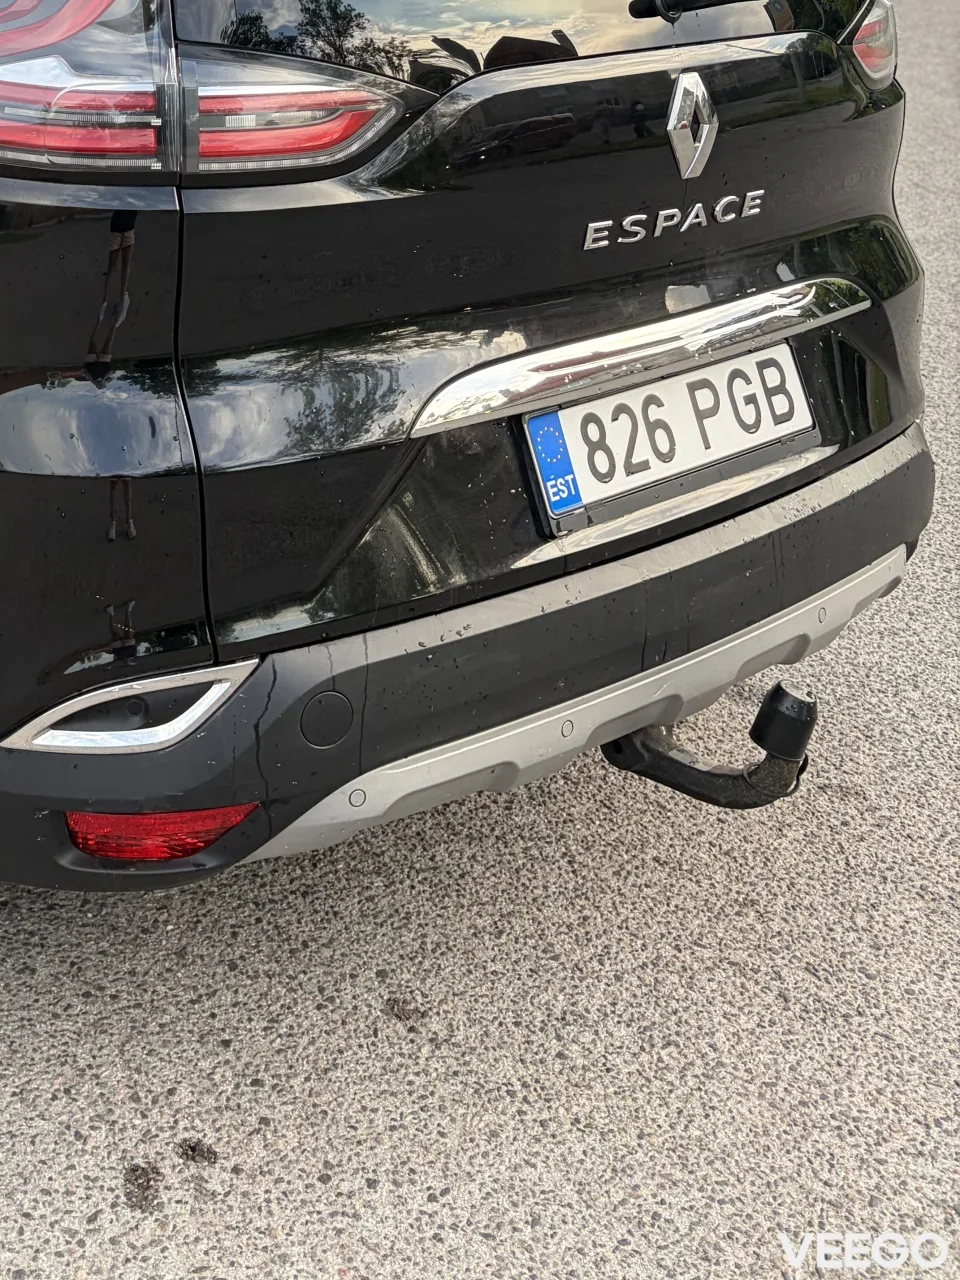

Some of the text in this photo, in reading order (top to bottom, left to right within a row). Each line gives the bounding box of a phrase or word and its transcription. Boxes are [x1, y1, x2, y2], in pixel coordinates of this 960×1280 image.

[583, 189, 765, 251] ESPACE
[579, 356, 796, 484] 826 PGB
[548, 473, 576, 503] EST
